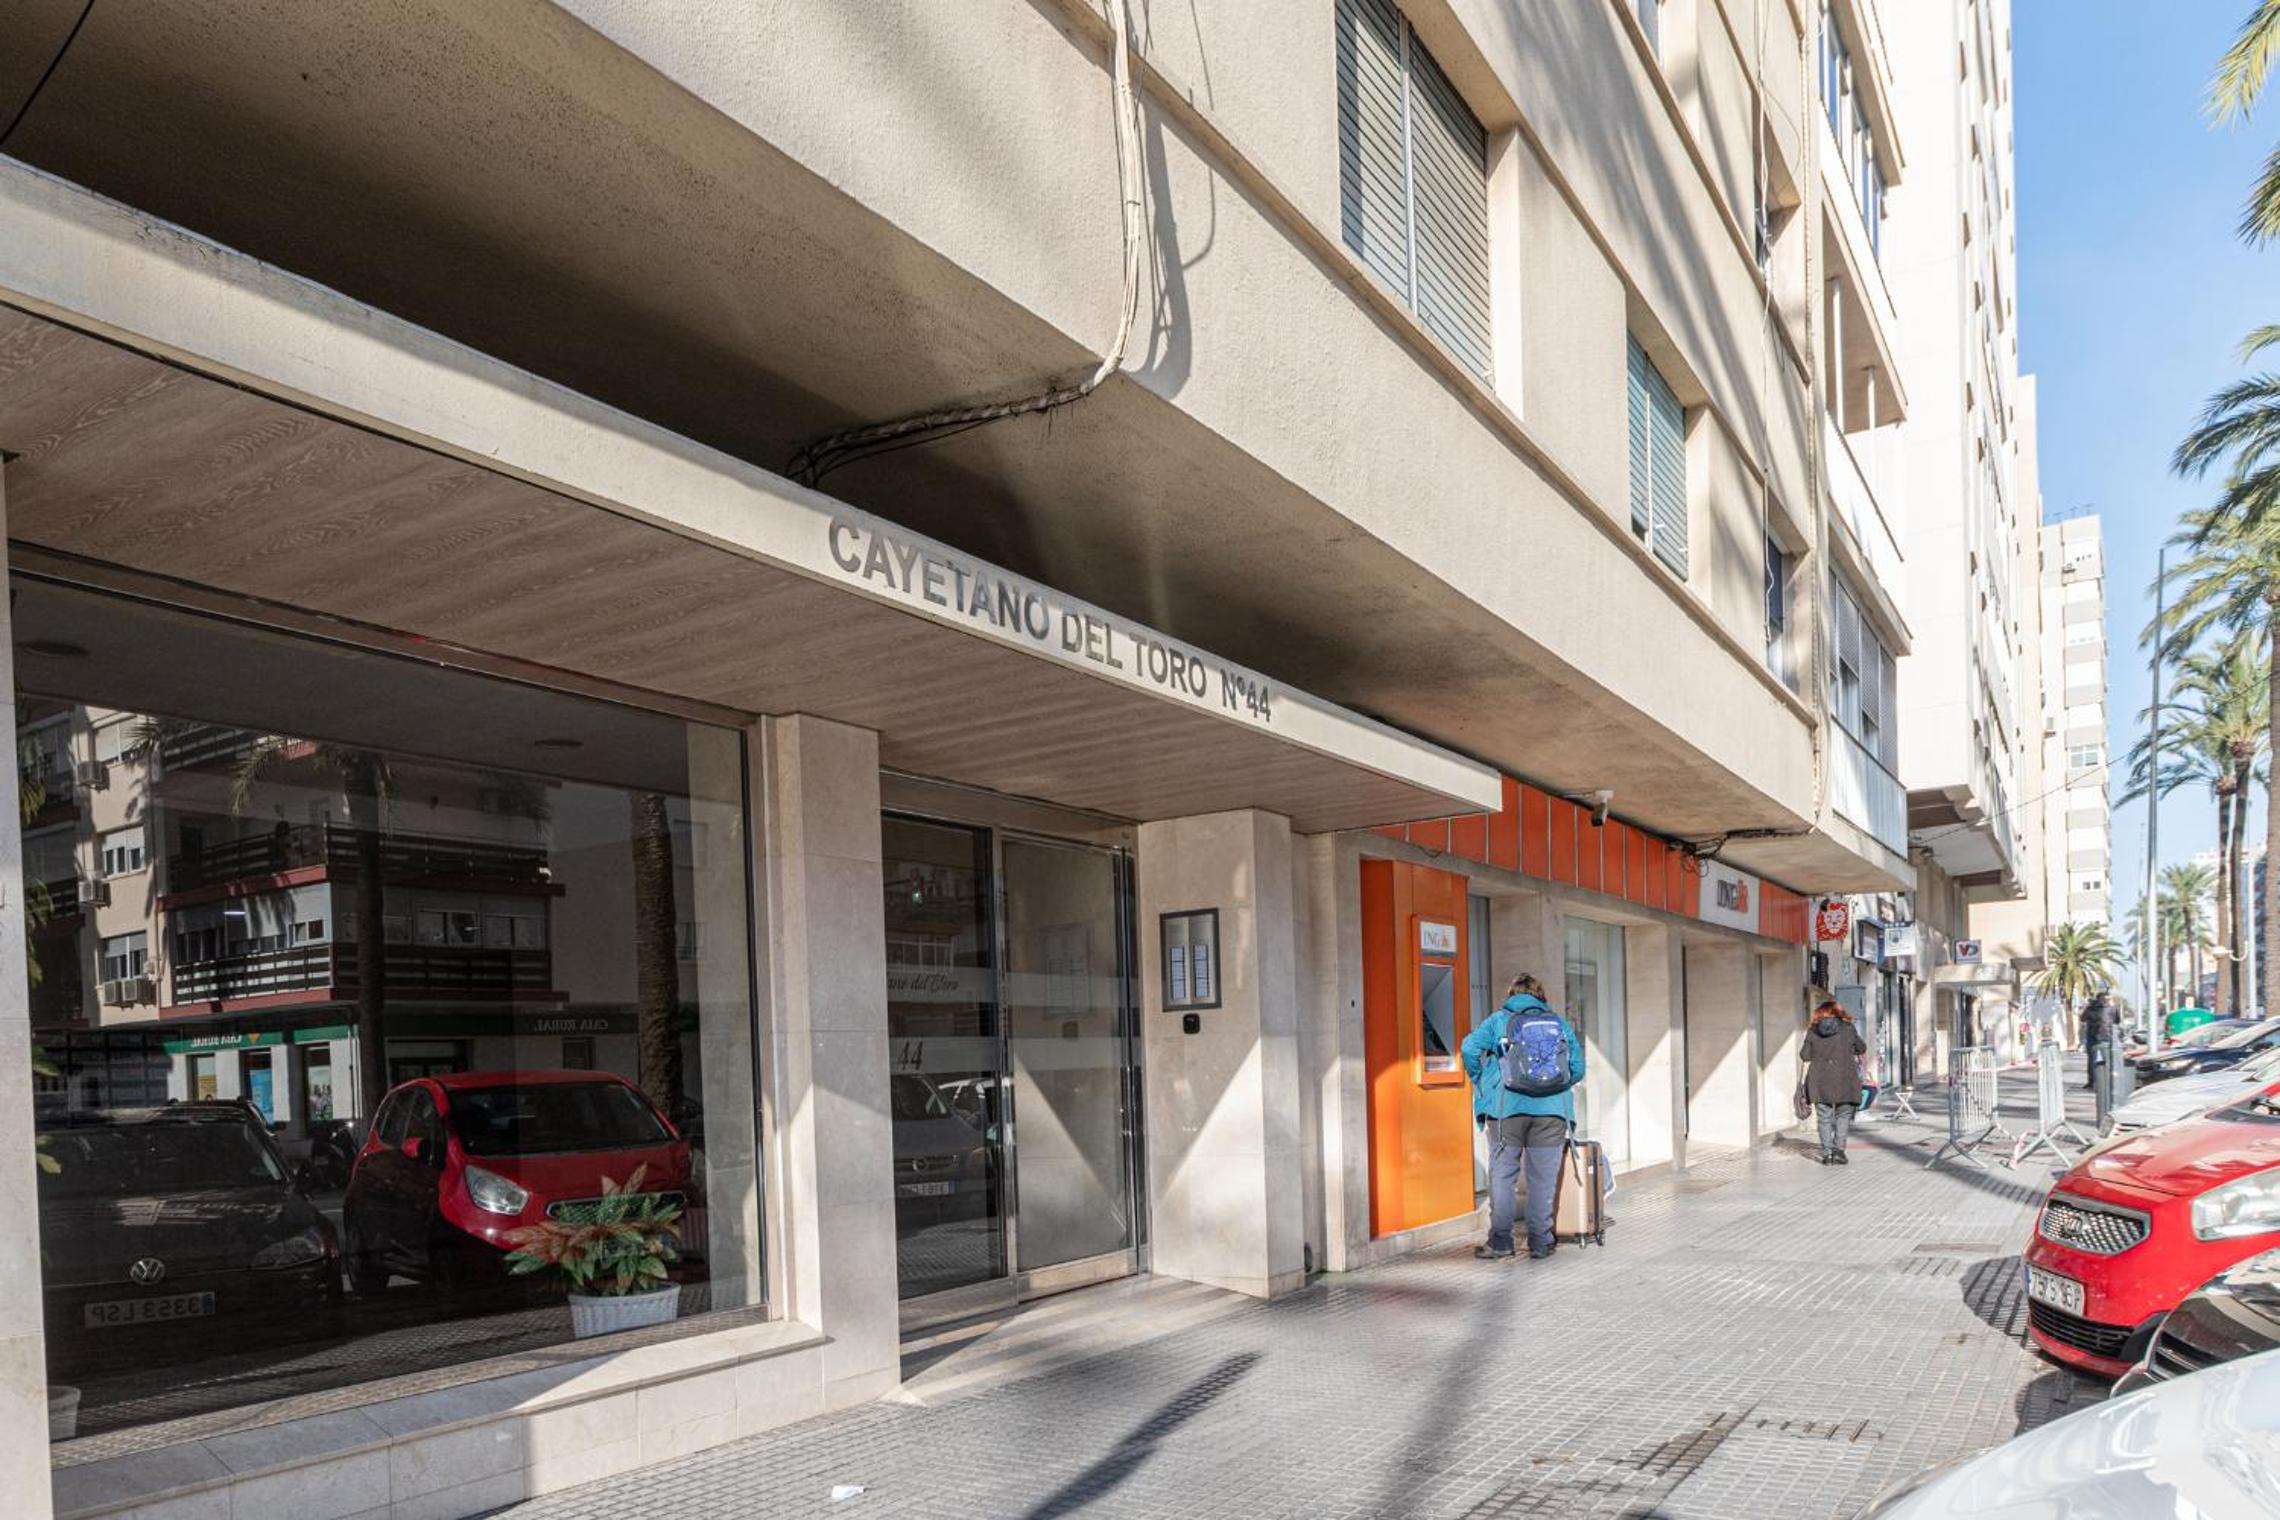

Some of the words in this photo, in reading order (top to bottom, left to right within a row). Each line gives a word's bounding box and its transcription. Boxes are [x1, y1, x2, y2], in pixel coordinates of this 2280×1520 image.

[828, 516, 1050, 640] CAYETANO
[1061, 612, 1123, 668] DEL
[1129, 632, 1208, 698] TORO
[898, 1041, 923, 1070] 44
